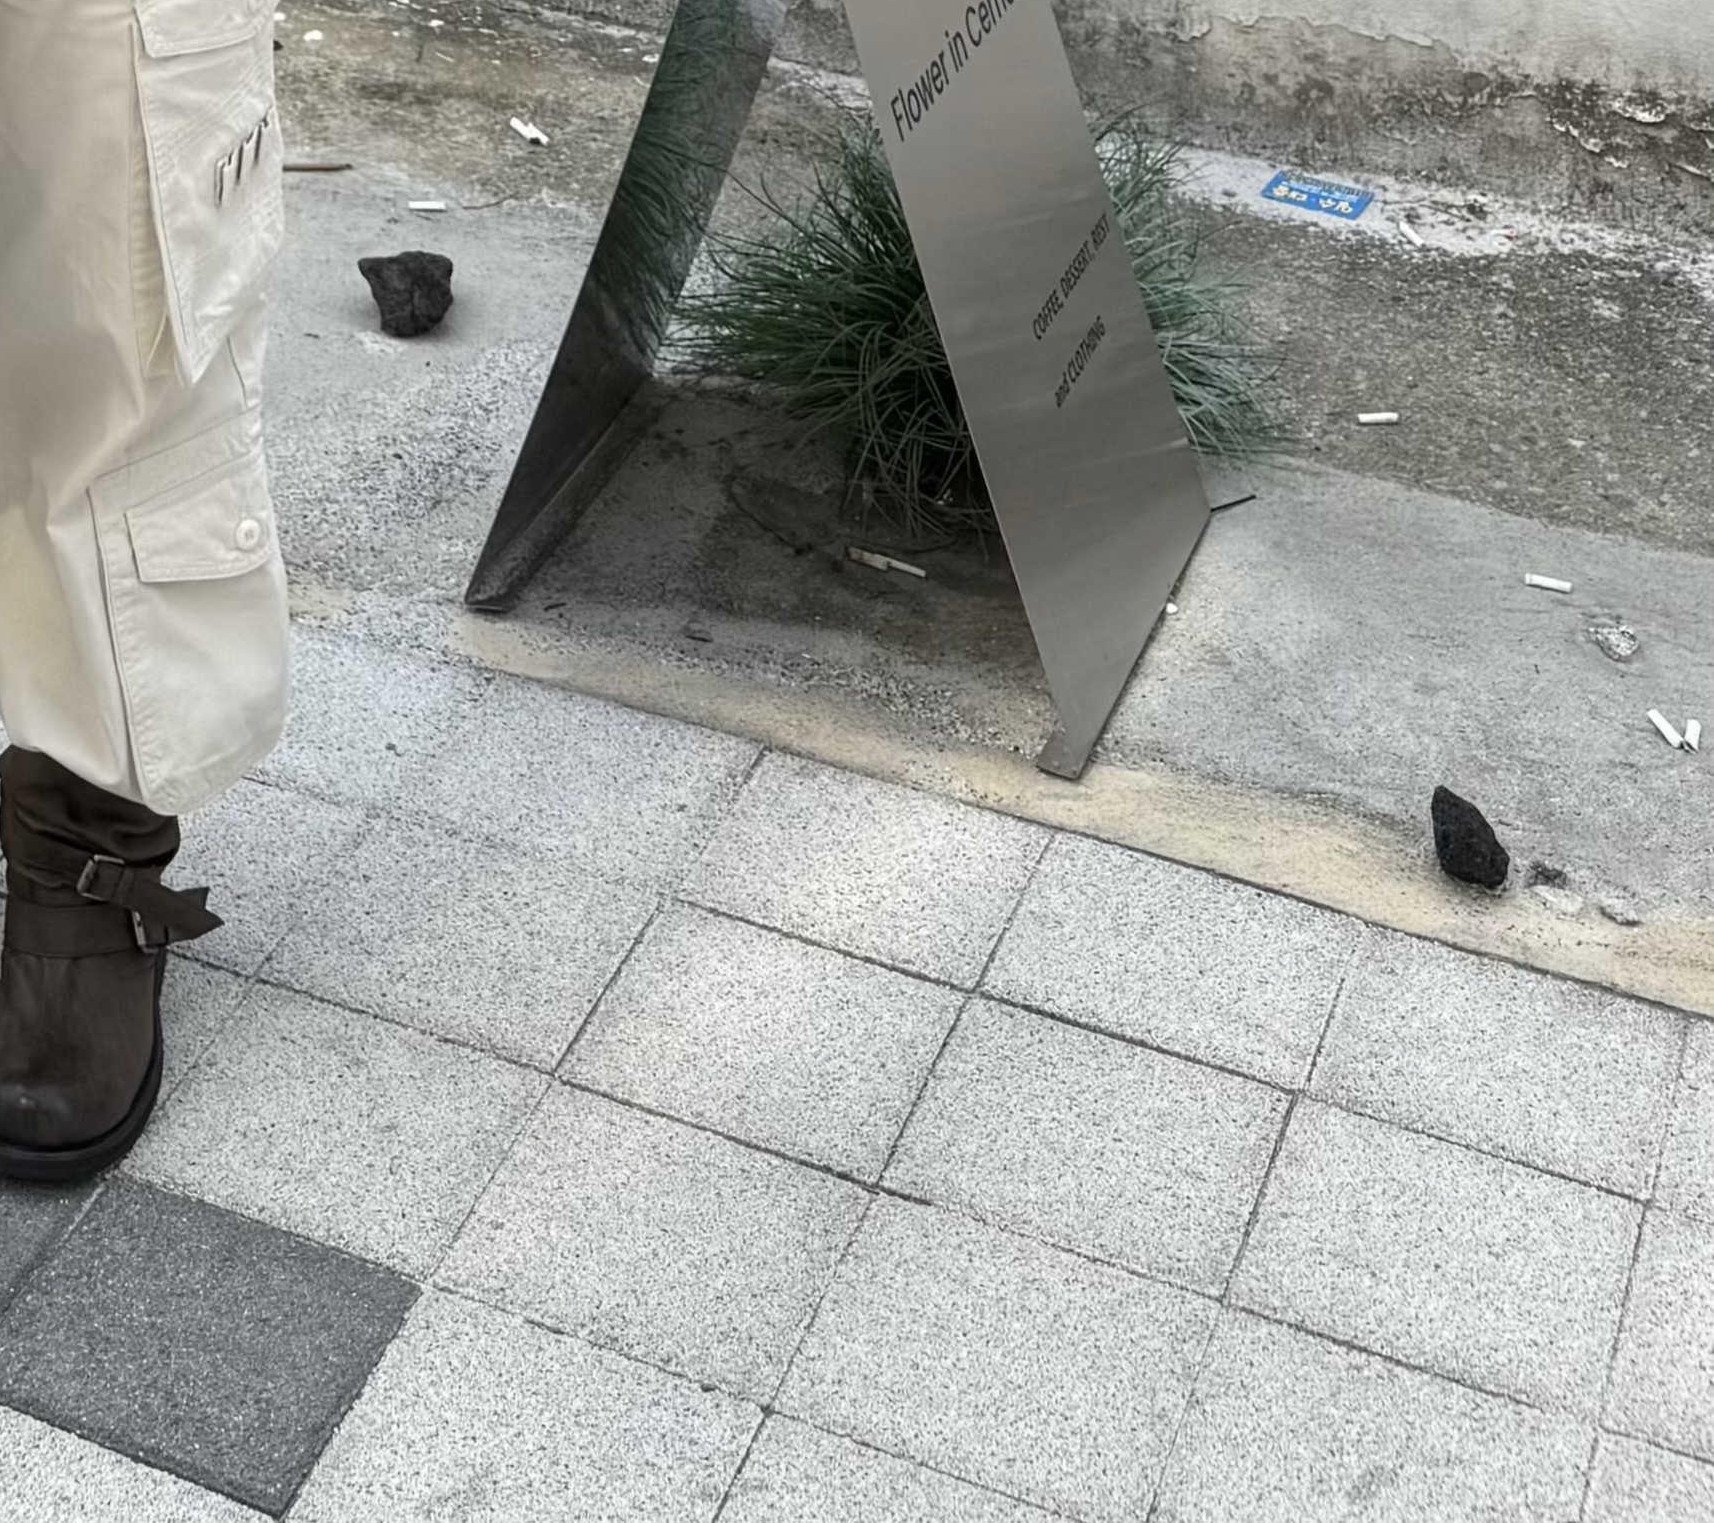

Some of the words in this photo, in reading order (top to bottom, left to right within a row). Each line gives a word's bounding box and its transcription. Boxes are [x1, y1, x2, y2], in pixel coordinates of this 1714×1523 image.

[890, 50, 949, 142] Flower
[945, 30, 969, 73] in
[1067, 315, 1106, 383] CLOTHING
